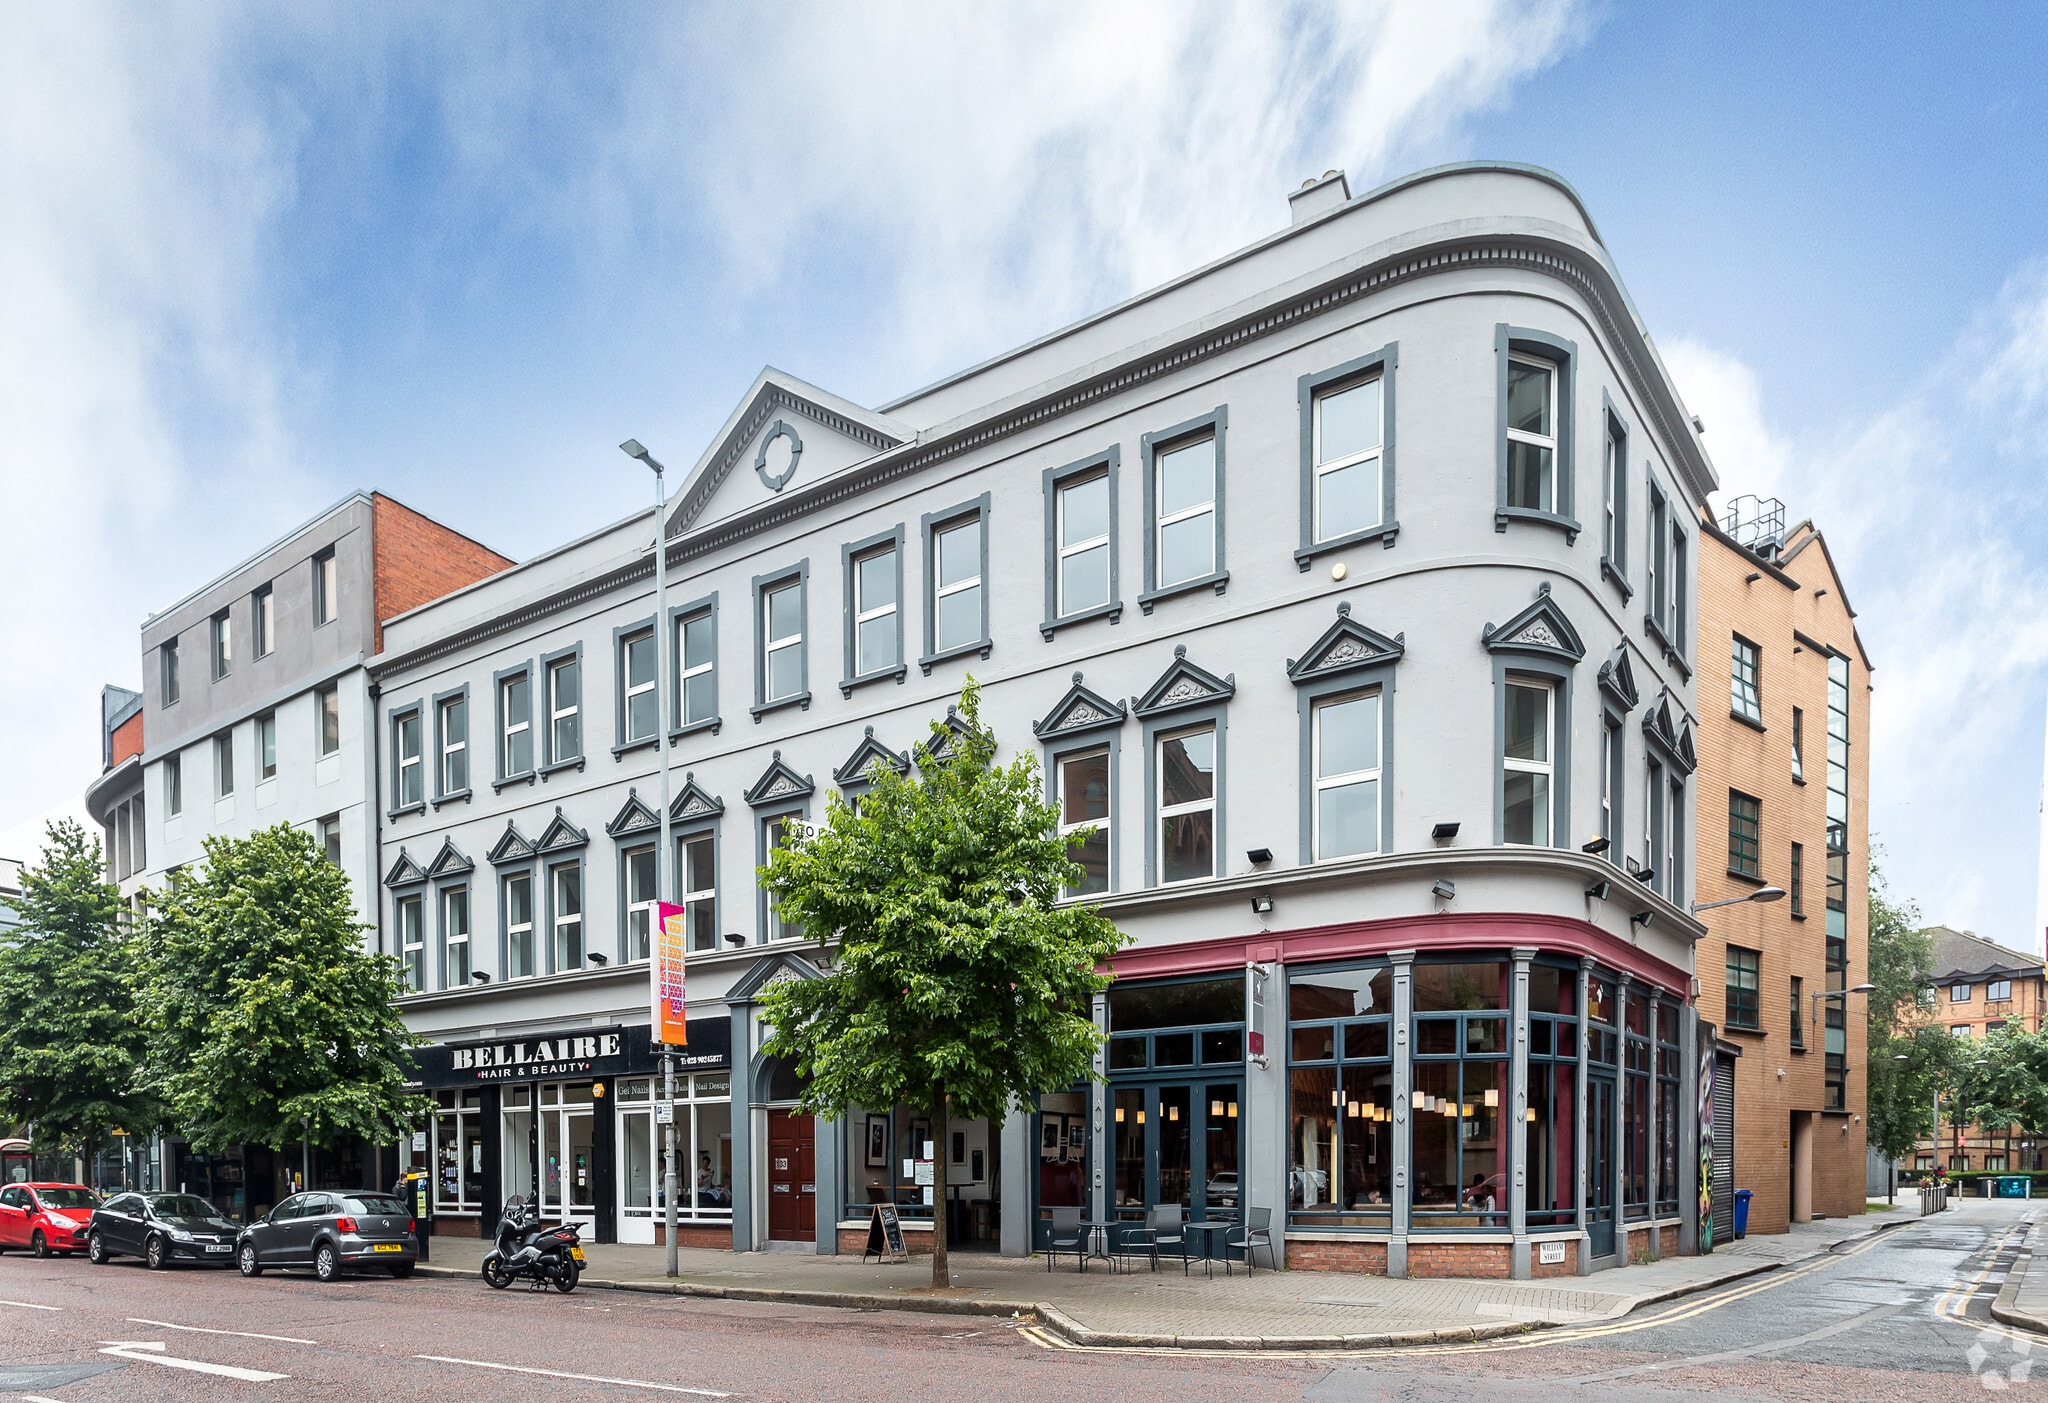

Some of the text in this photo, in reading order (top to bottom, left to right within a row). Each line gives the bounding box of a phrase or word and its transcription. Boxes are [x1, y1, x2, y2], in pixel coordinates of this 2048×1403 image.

[452, 1033, 621, 1070] BELLAIRE
[481, 1062, 585, 1079] HAIR & BEAUTY
[618, 1086, 630, 1095] Gel
[631, 1084, 650, 1094] Nails
[695, 1081, 730, 1091] Nail Design
